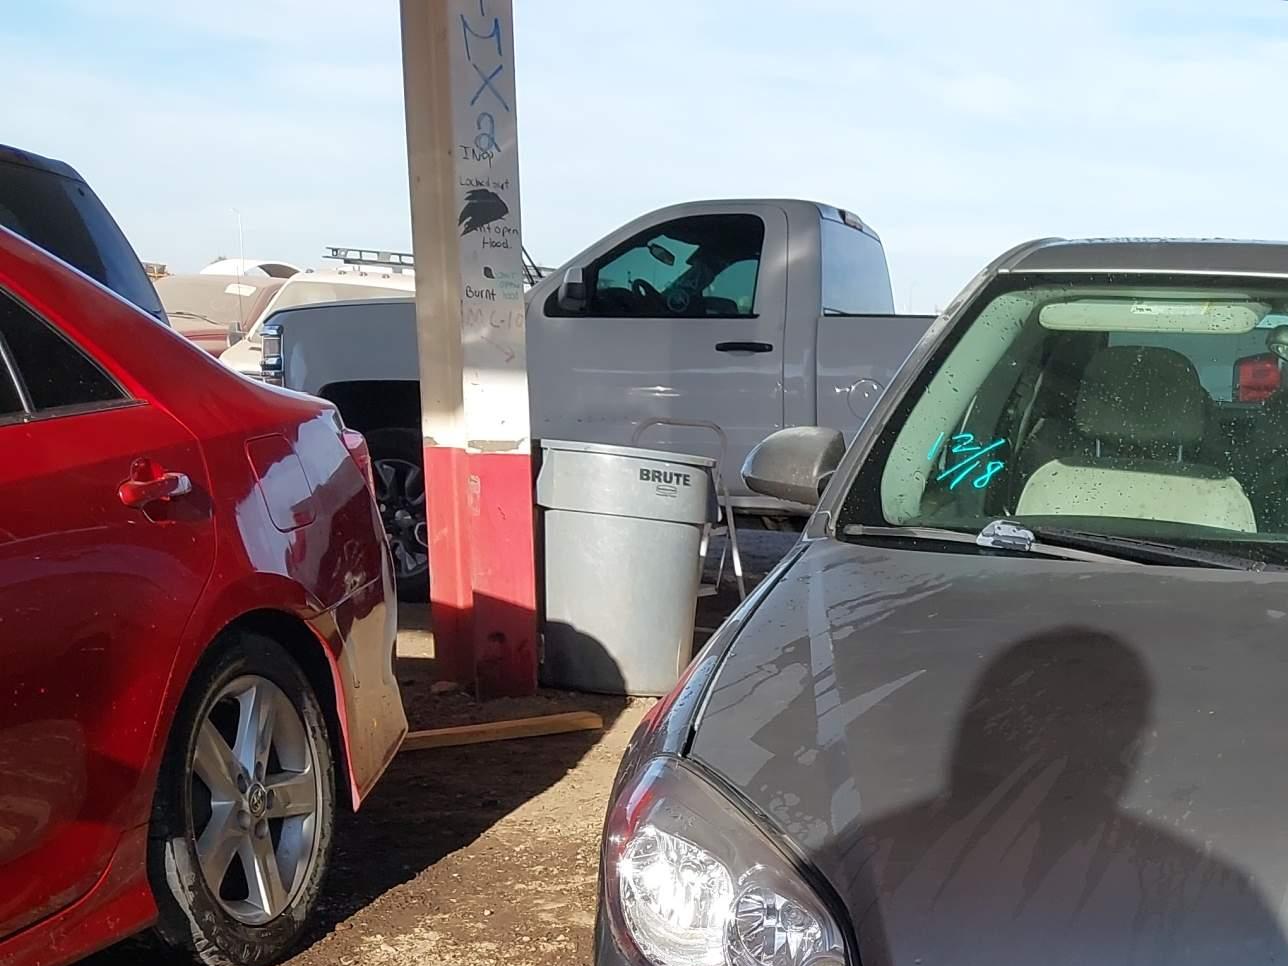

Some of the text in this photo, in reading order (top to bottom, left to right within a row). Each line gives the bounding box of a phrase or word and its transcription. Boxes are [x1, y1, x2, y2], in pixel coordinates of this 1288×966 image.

[465, 286, 496, 301] Burnt
[926, 431, 1006, 489] 12/18
[639, 468, 691, 486] BRUTE
